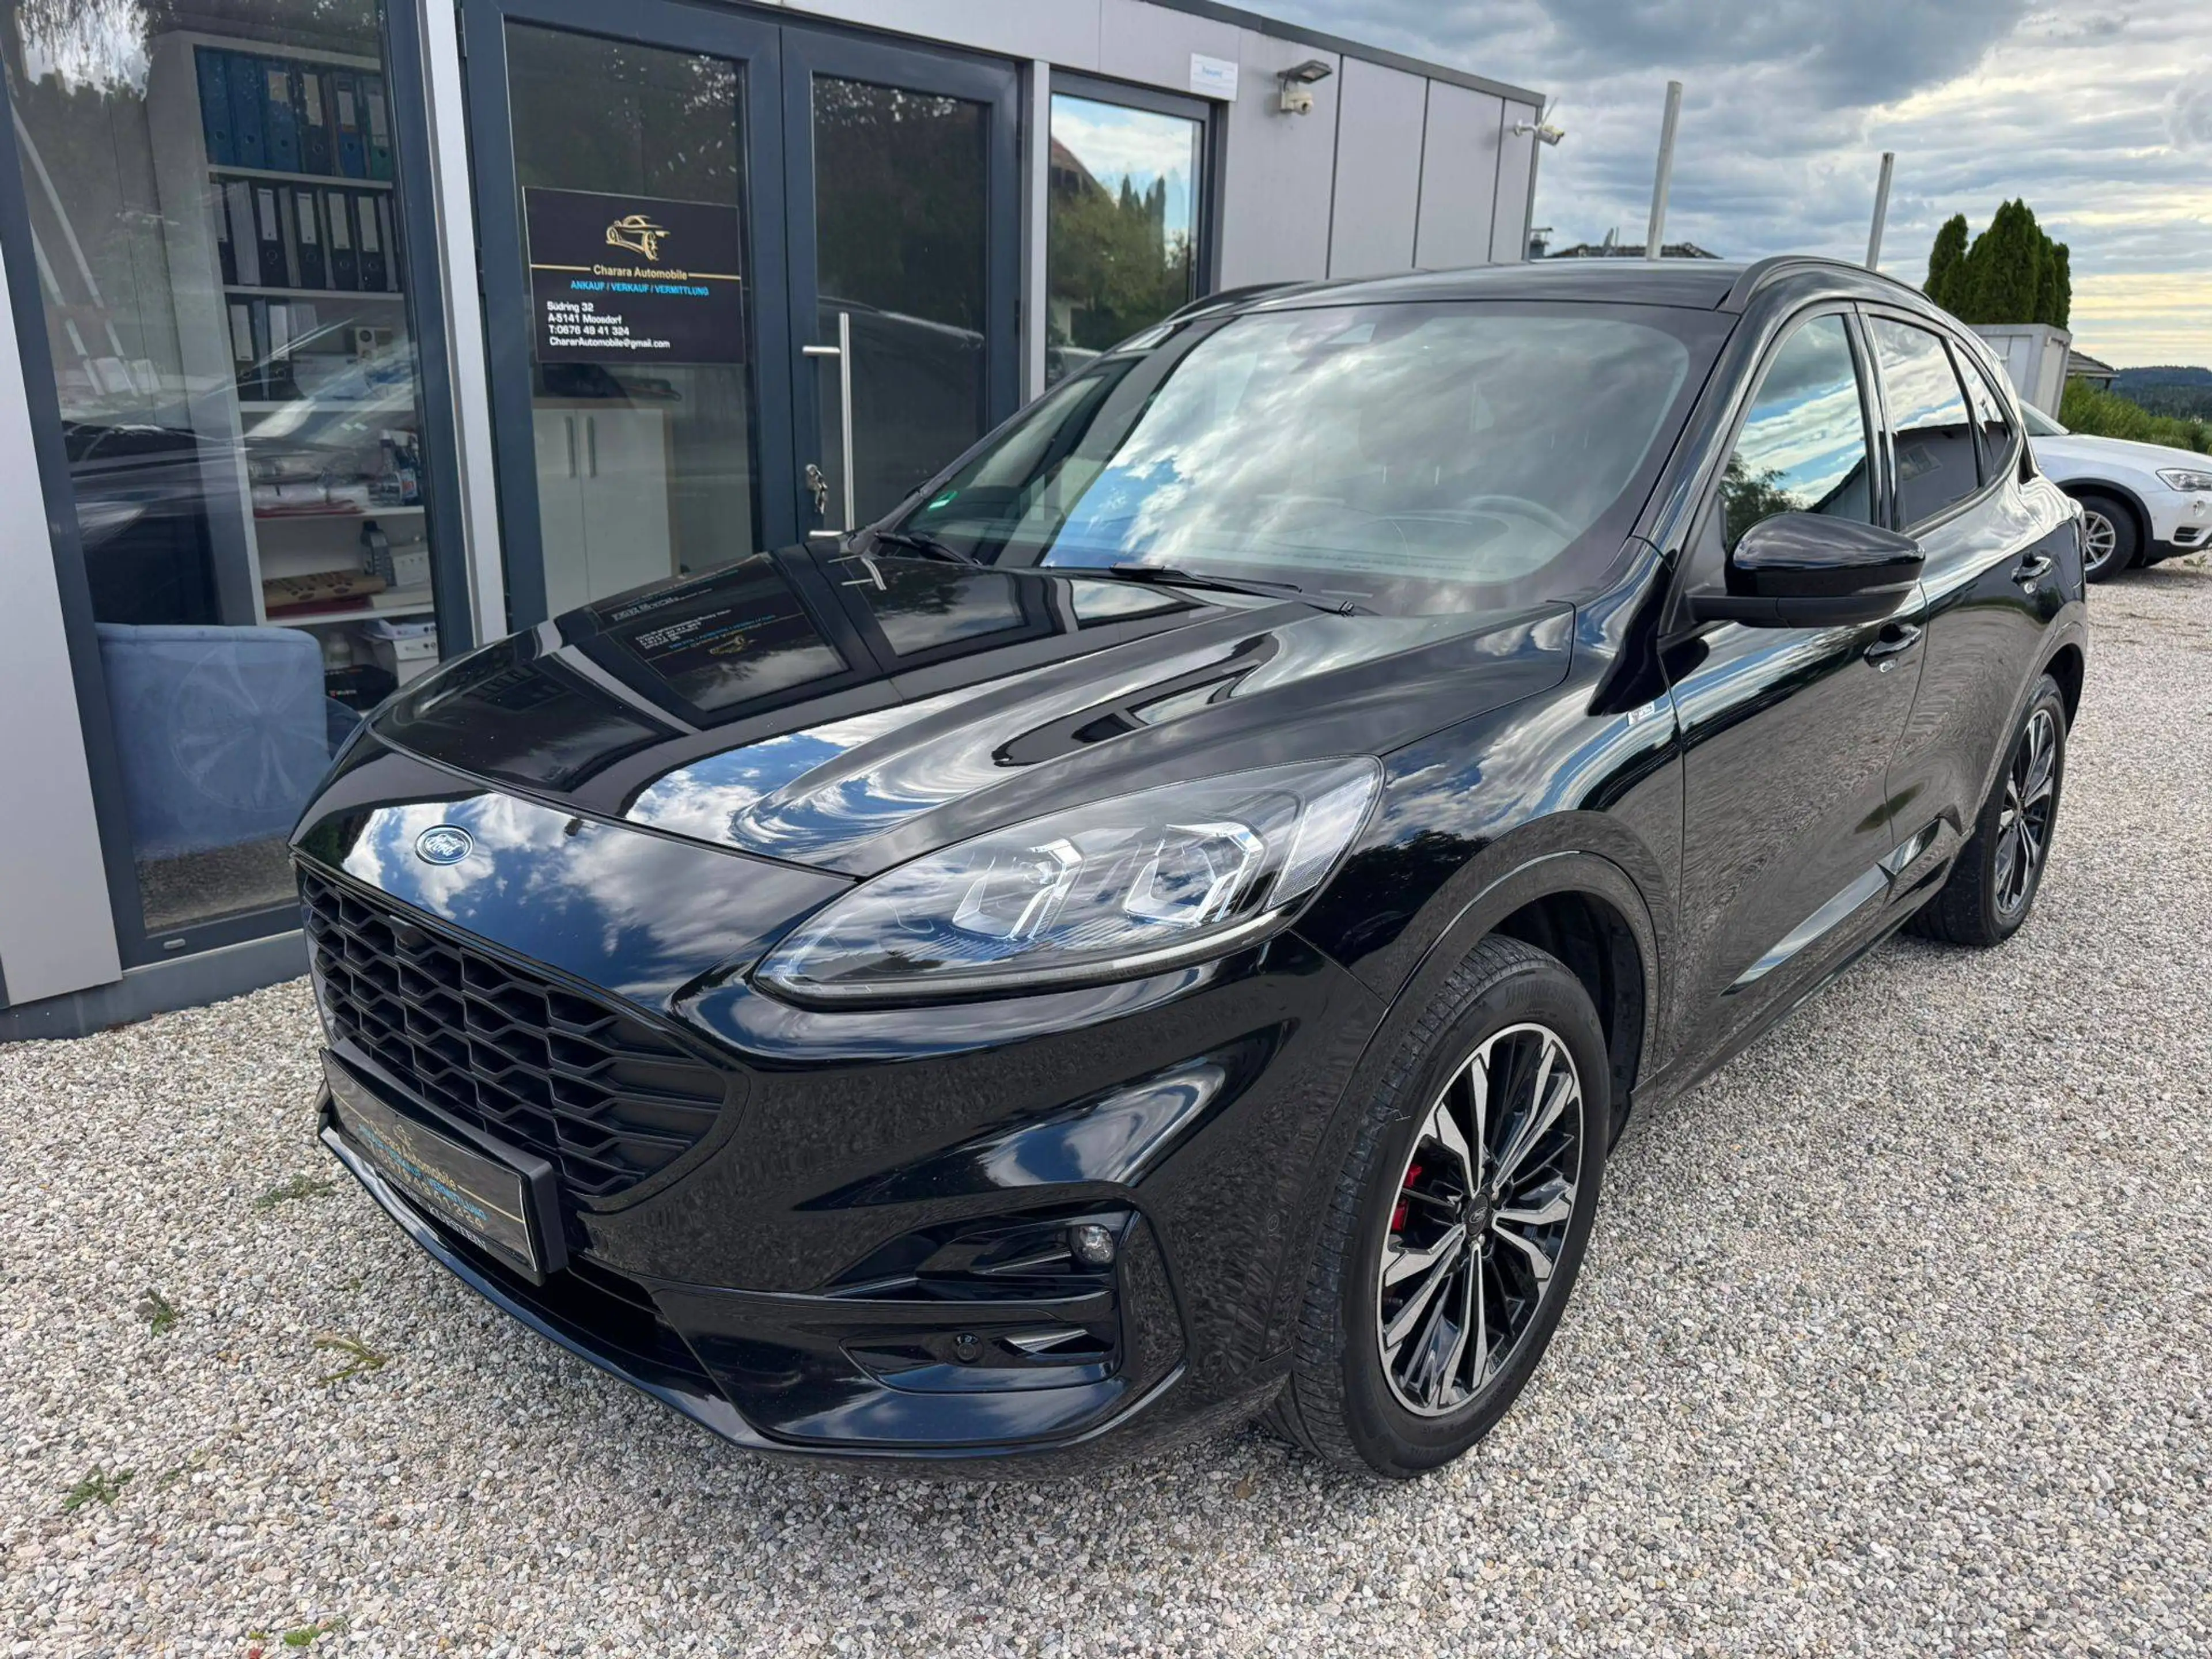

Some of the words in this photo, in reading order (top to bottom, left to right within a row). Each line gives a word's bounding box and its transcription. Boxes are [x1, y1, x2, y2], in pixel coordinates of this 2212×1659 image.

[593, 264, 632, 276] Charara
[634, 267, 688, 281] Automobile
[570, 280, 604, 291] ANKAUF
[611, 281, 650, 293] VERKAUF
[655, 284, 709, 296] VERMITTLUNG
[547, 301, 579, 313] Südring
[581, 302, 594, 312] 32
[548, 312, 580, 323] A-5141
[582, 314, 622, 324] Moosdorf
[548, 324, 581, 335] T:0676
[597, 325, 609, 335] 41
[612, 326, 630, 336] 324
